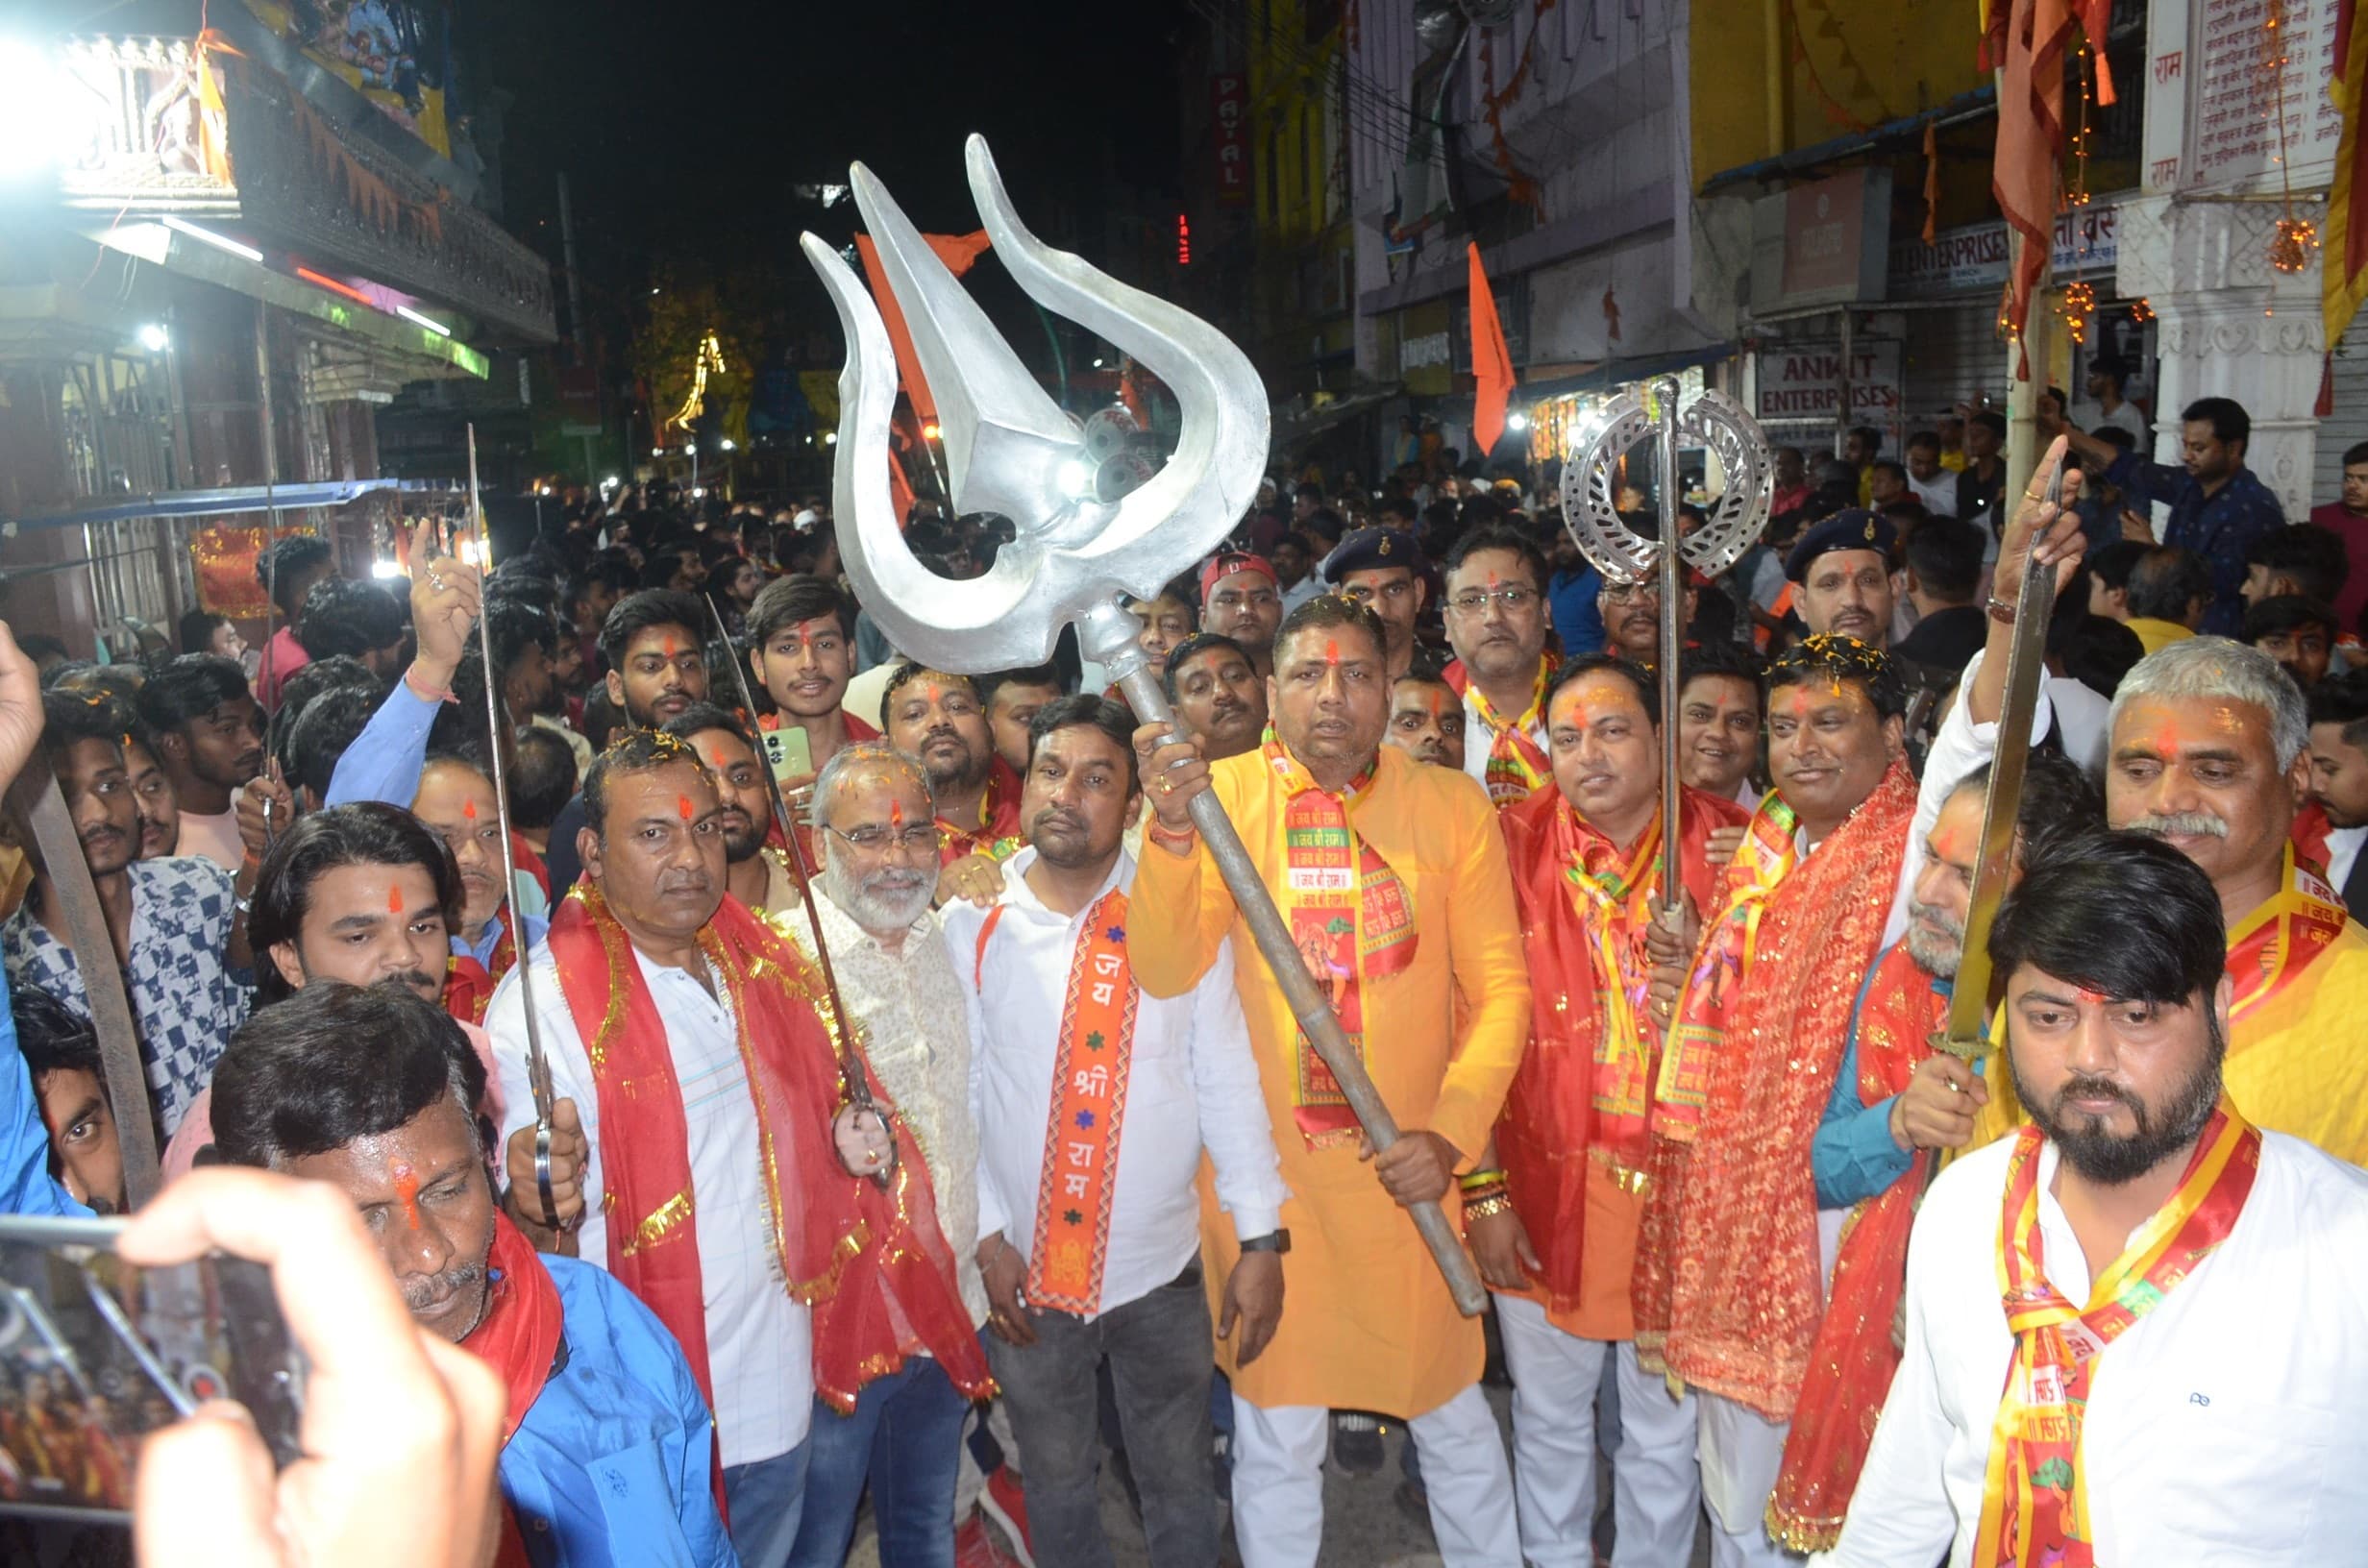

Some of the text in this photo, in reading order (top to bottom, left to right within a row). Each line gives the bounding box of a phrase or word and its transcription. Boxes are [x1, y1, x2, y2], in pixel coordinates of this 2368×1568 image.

[2153, 51, 2183, 85] राम
[1219, 78, 1240, 184] PAYAL
[2152, 158, 2178, 188] राम
[1763, 385, 1892, 413] ENTERPISES
[1298, 833, 1312, 845] जय
[1324, 833, 1339, 845] राम
[1299, 852, 1314, 866] जय
[1324, 852, 1340, 867] राम
[1300, 874, 1314, 886] जय
[1326, 874, 1341, 888] राम
[1066, 953, 1122, 1199] जय श्री राम
